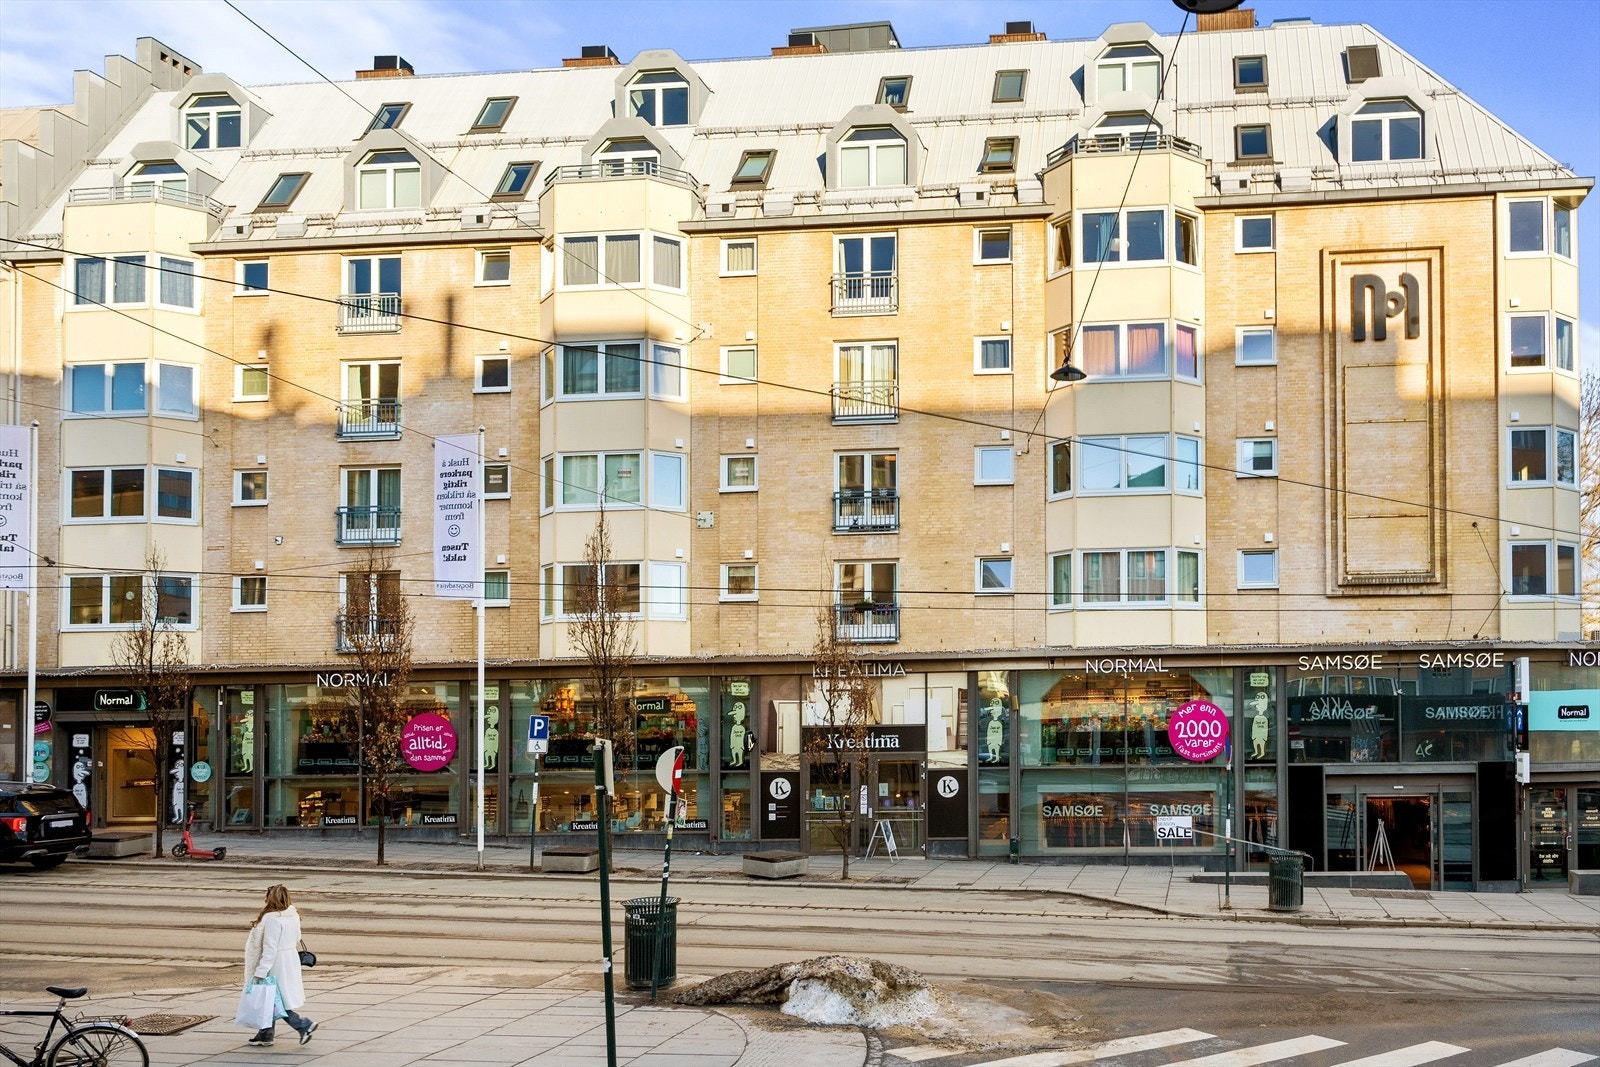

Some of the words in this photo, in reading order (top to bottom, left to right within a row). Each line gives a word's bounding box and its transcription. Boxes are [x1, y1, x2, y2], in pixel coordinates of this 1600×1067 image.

[1085, 658, 1169, 674] NORMAL
[1298, 654, 1383, 671] SAMSØE
[1419, 652, 1505, 669] SAMSØE
[316, 672, 393, 687] NORMAL
[100, 693, 133, 706] Normal
[1178, 703, 1197, 718] Mer
[1199, 704, 1217, 717] enn
[1561, 706, 1587, 717] Normal
[413, 723, 434, 732] Prisen
[533, 718, 545, 737] P
[1174, 719, 1222, 738] 2000
[1184, 738, 1215, 748] varer
[1177, 744, 1191, 757] fast
[1191, 742, 1223, 759] sortiment
[423, 754, 447, 762] samme
[774, 781, 790, 796] K
[942, 779, 957, 794] K
[1043, 805, 1104, 817] SAMSØE
[1150, 804, 1212, 816] SAMSØE
[325, 815, 356, 824] Kreatima
[424, 813, 455, 824] Kreatima
[1158, 827, 1192, 838] SALE
